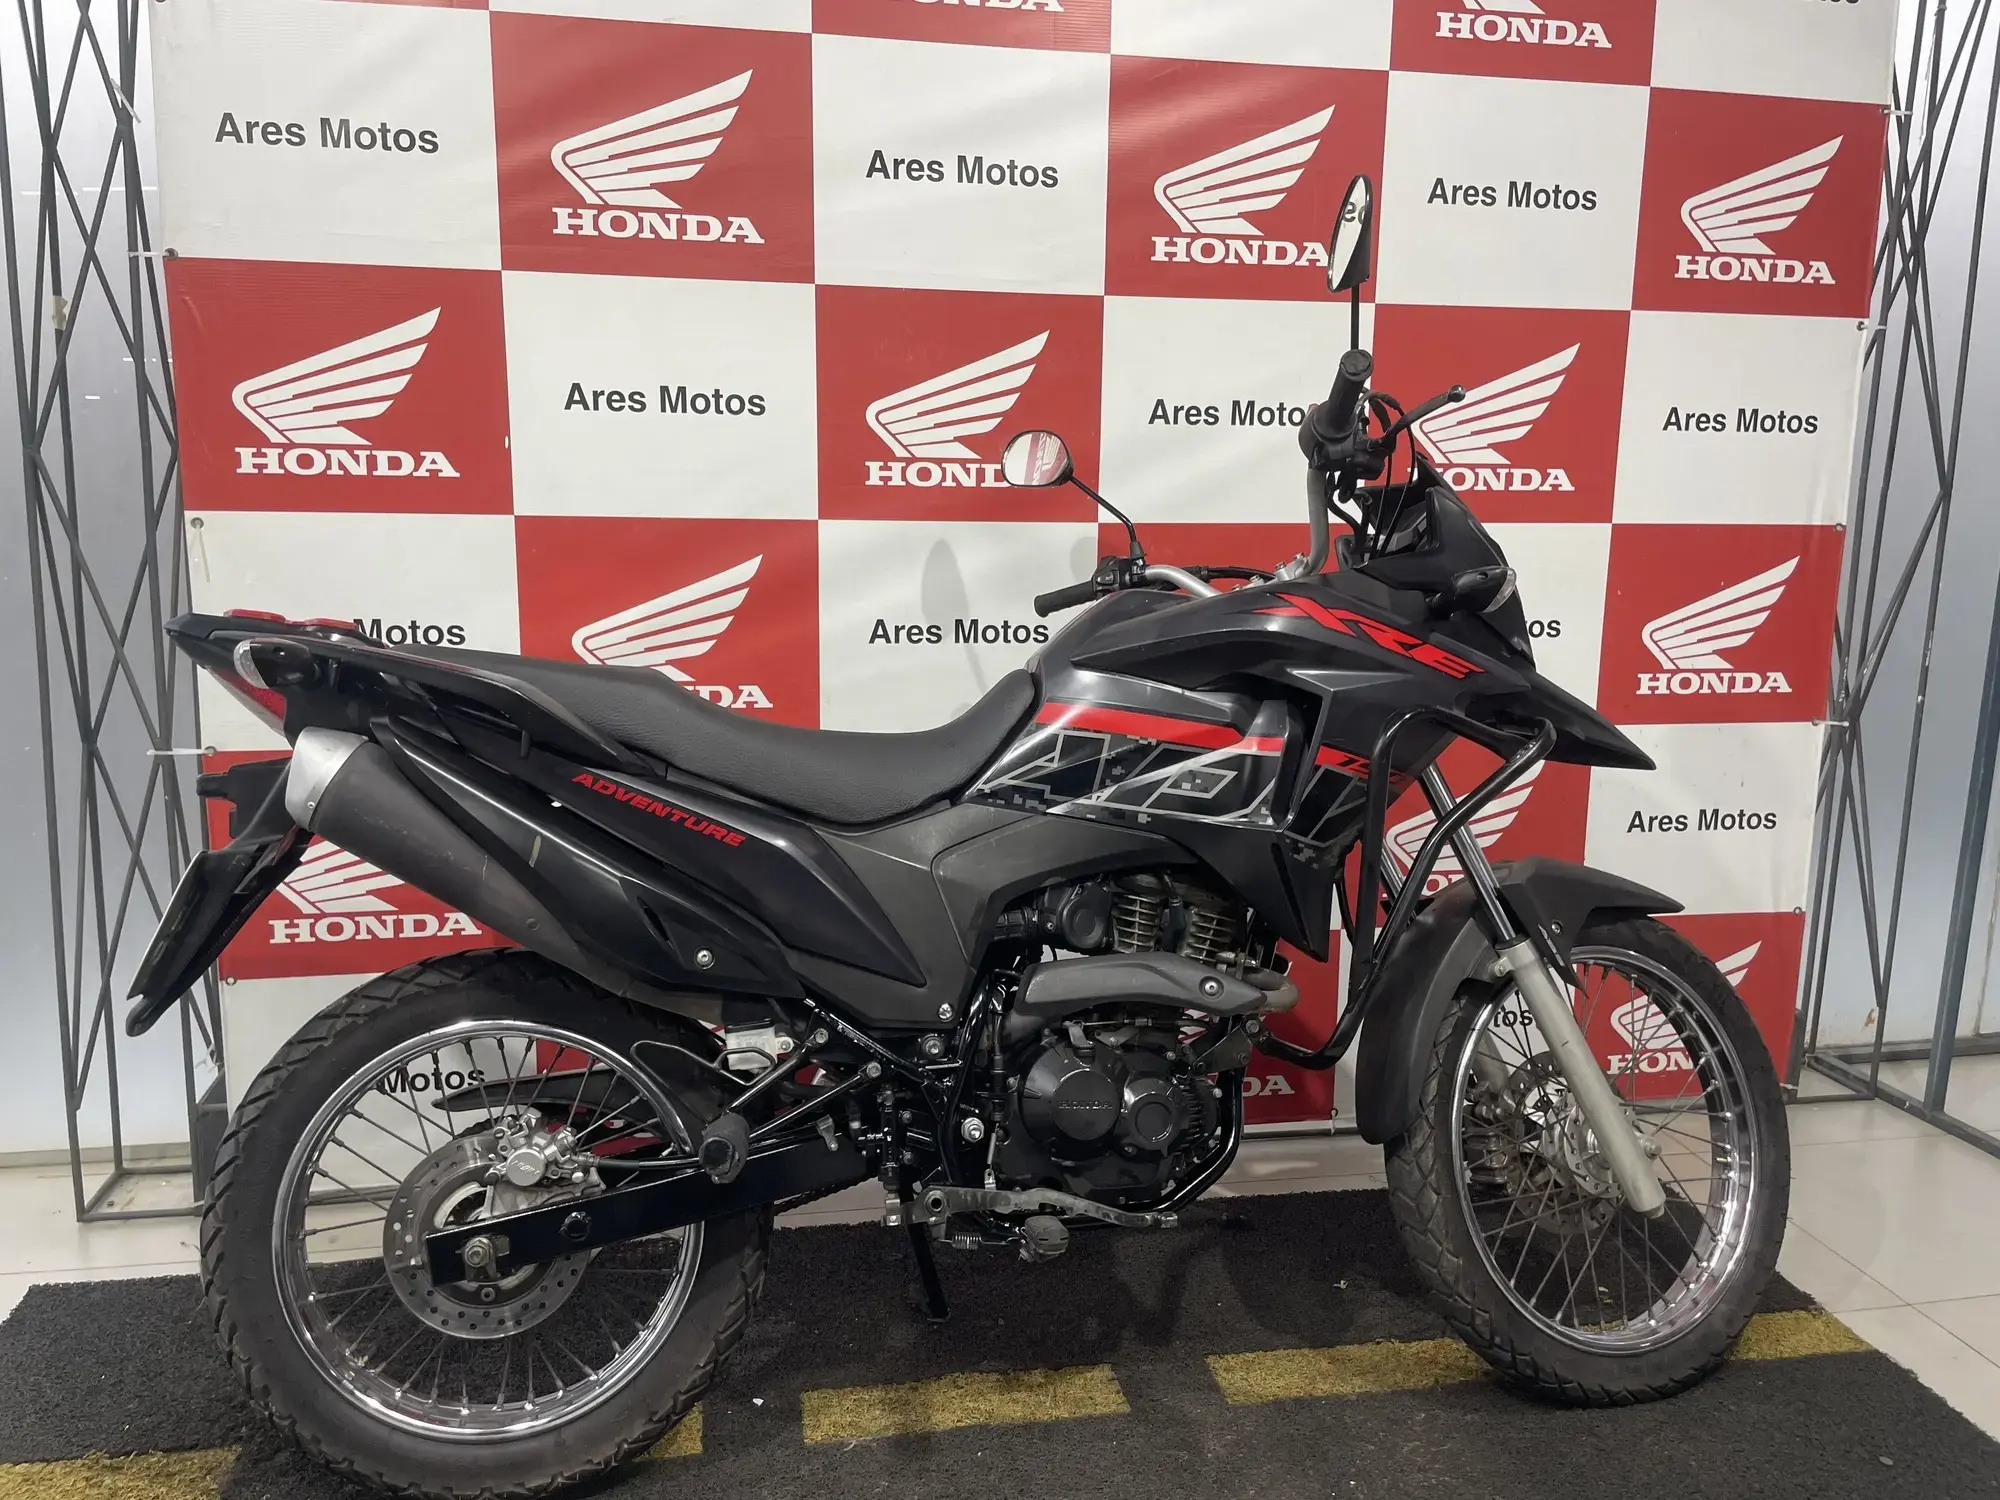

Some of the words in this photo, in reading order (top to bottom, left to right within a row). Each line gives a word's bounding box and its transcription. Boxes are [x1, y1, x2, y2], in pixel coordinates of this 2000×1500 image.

[1435, 12, 1613, 49] HONDA
[215, 112, 306, 147] Ares
[319, 117, 439, 154] Motos
[865, 149, 945, 183] Ares
[957, 154, 1059, 188] Motos
[1427, 177, 1497, 207] Ares
[1507, 180, 1597, 211] Motos
[551, 206, 766, 244] HONDA
[1150, 236, 1329, 267] HONDA
[1674, 254, 1836, 285] HONDA
[564, 382, 647, 413] Ares
[659, 385, 766, 416] Motos
[1148, 398, 1220, 426] Ares
[1230, 399, 1306, 427] Moto
[1662, 406, 1727, 433] Ares
[1736, 408, 1818, 434] Motos
[235, 447, 461, 478] HONDA
[864, 461, 1012, 488] HOND
[353, 618, 466, 646] Motos
[868, 618, 943, 645] Ares
[954, 618, 1050, 645] Motos
[1635, 671, 1793, 695] HONDA
[571, 771, 747, 848] ADVENTURE
[1626, 810, 1688, 834] Ares
[1697, 808, 1777, 831] Motos
[268, 911, 483, 945] HONDA
[1607, 1051, 1694, 1075] HON
